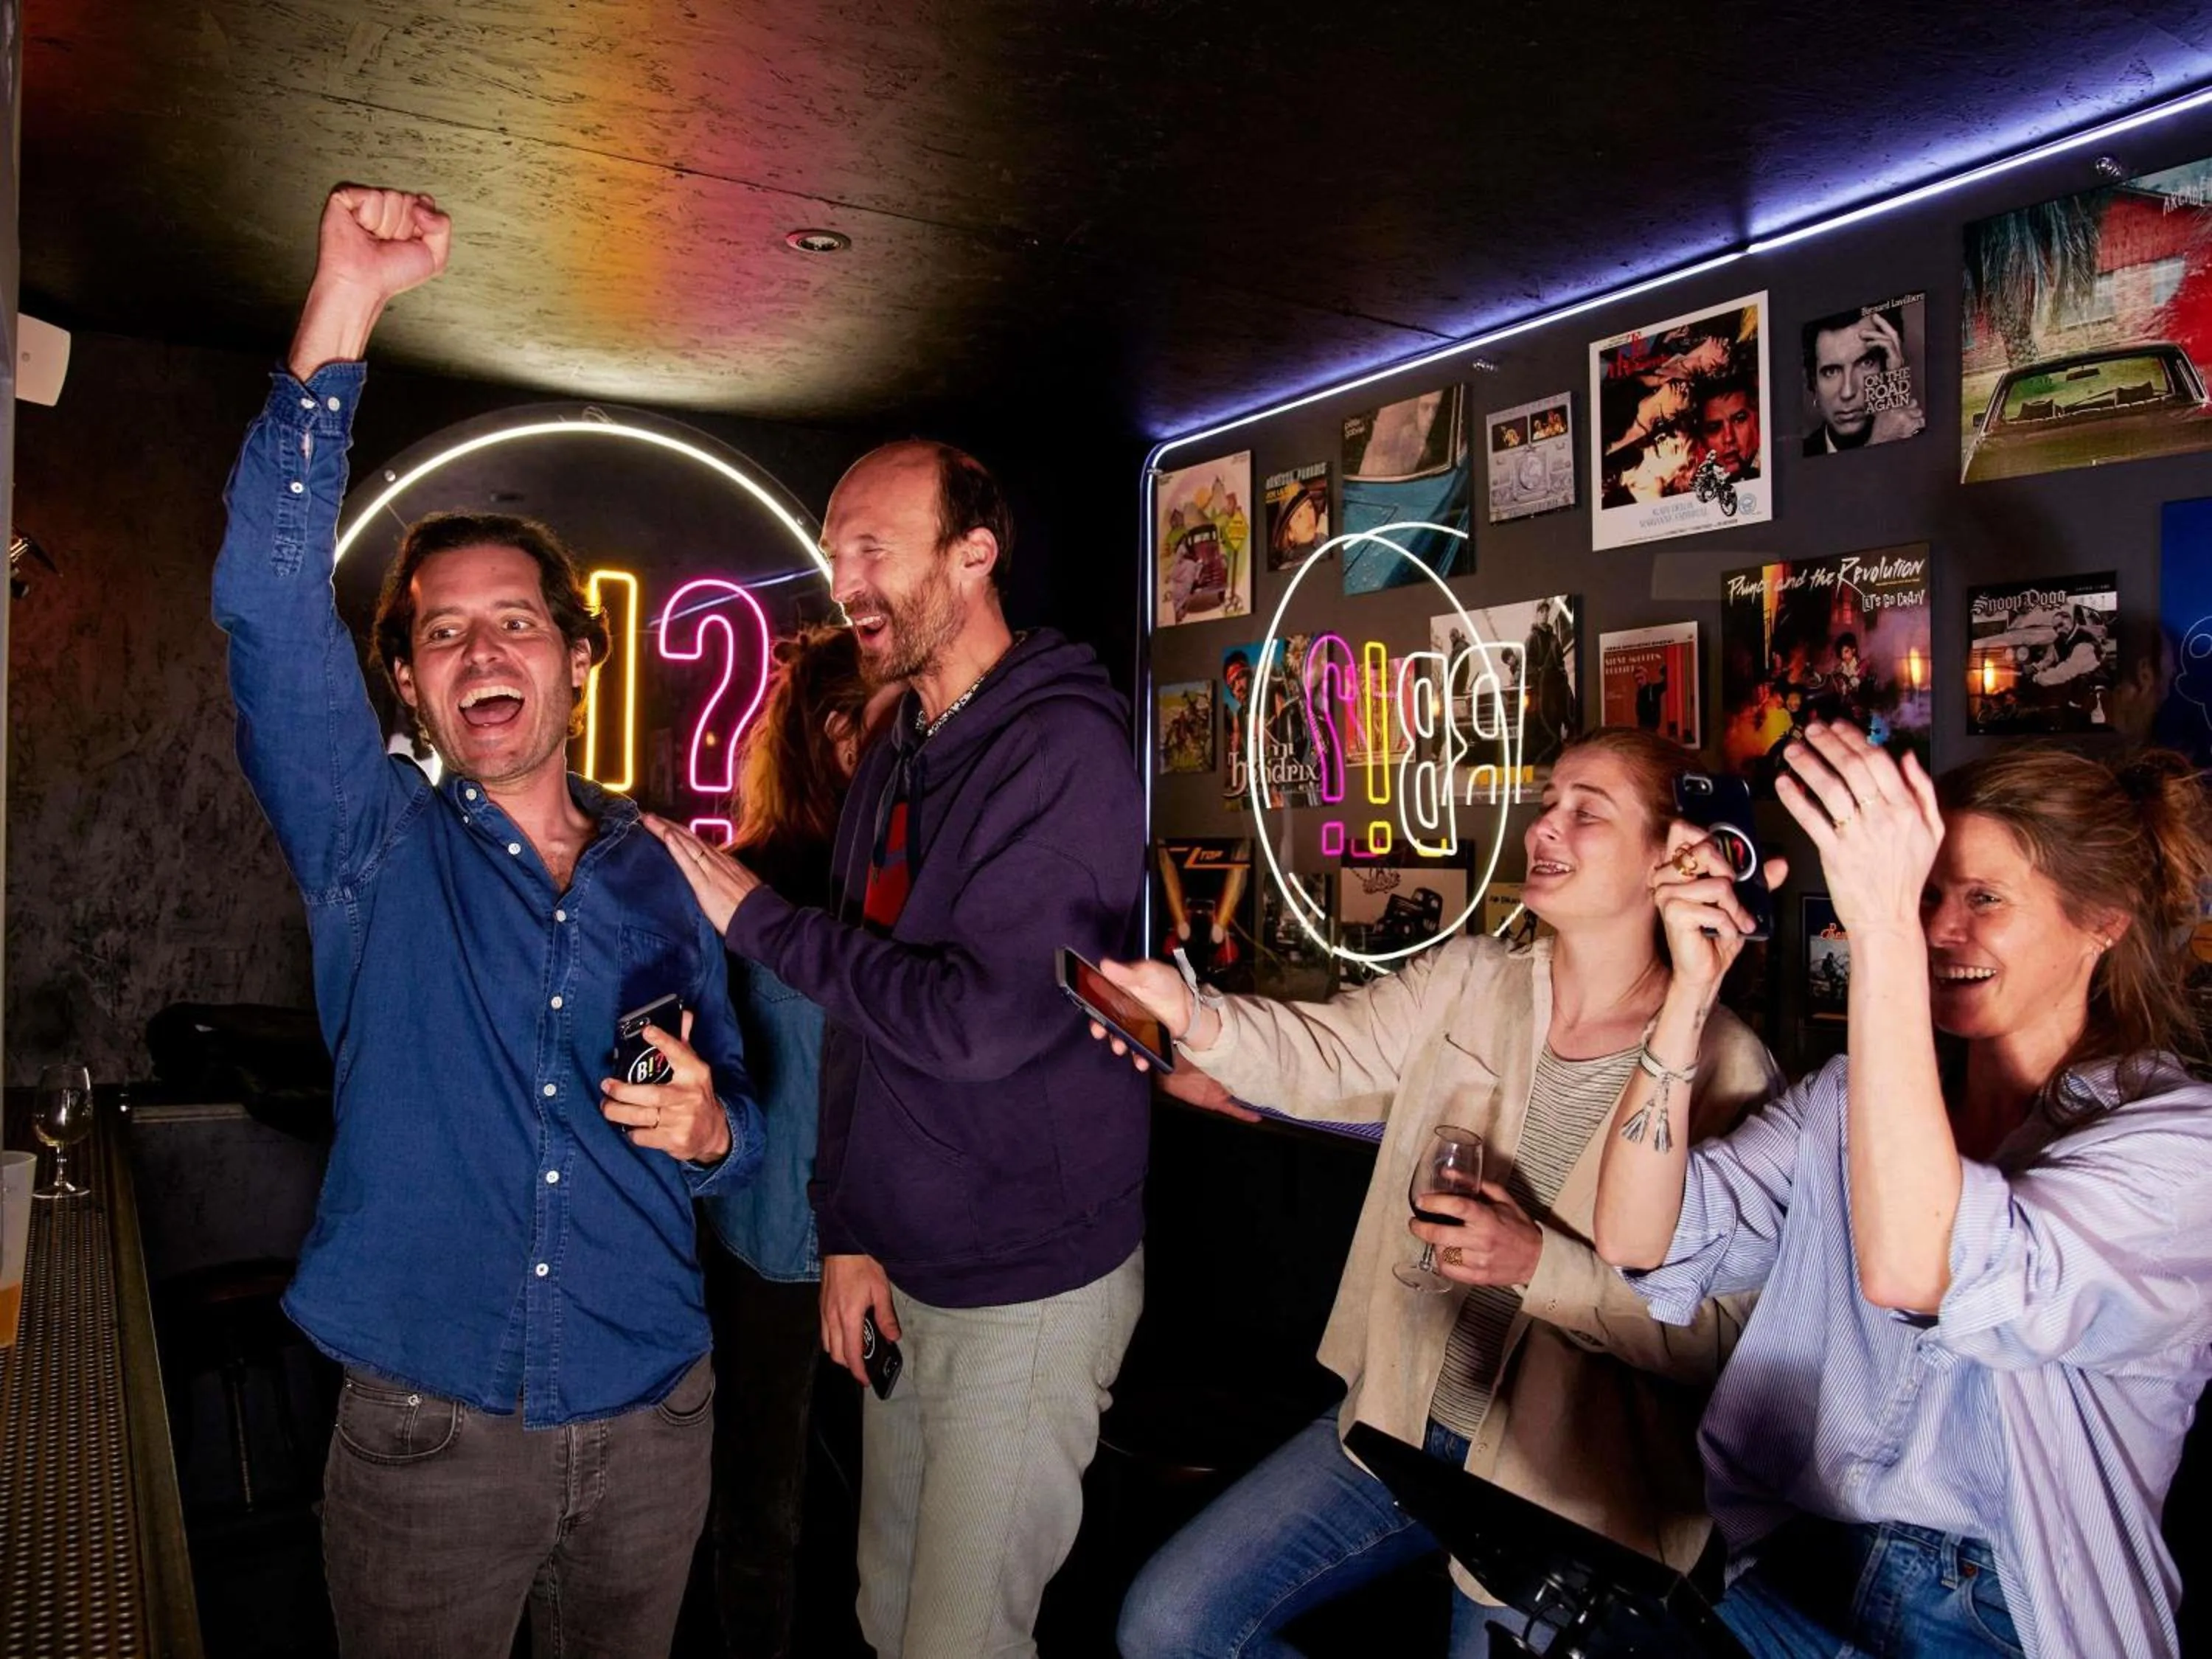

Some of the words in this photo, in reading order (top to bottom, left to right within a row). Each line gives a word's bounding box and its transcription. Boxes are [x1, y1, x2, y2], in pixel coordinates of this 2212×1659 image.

[1865, 375, 1883, 388] ON
[1887, 367, 1911, 383] THE
[1865, 380, 1910, 402] ROAD
[1865, 393, 1910, 414] AGAIN
[1774, 568, 1807, 591] and
[1809, 567, 1836, 590] the
[1836, 555, 1925, 599] Revolution
[1897, 589, 1926, 607] CRAZY
[1971, 591, 2023, 615] Snoop
[2023, 588, 2067, 611] Dogg
[636, 1051, 668, 1083] B!?
